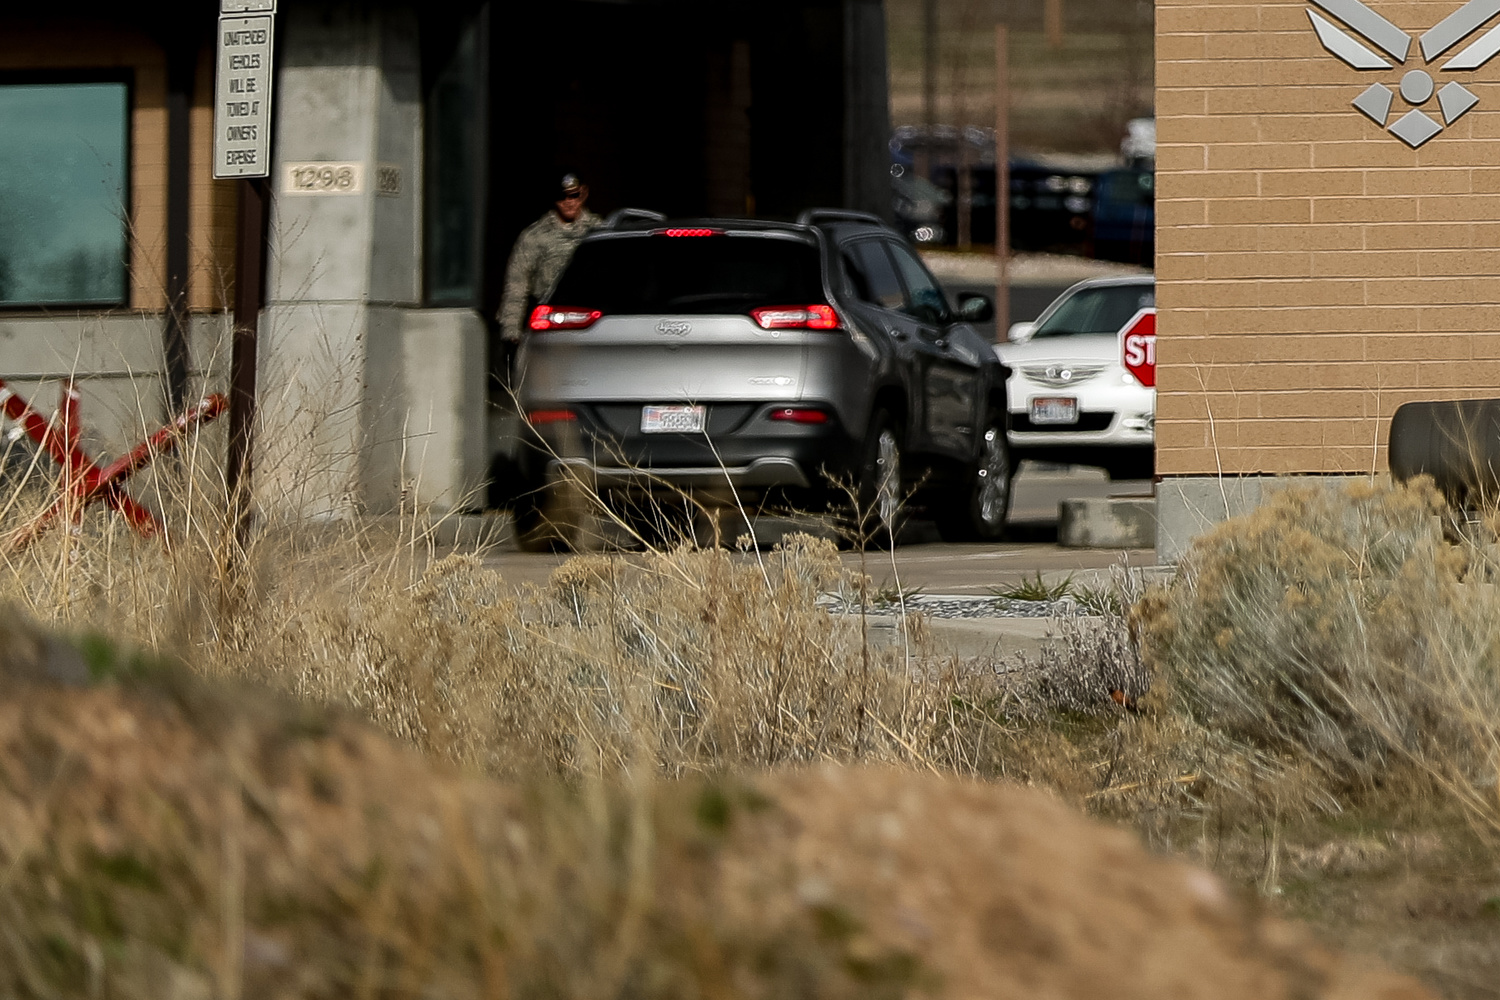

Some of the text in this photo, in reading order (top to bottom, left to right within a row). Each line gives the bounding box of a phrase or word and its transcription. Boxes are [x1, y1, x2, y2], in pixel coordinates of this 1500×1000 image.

[224, 30, 267, 46] UNATTENDED
[229, 53, 260, 69] VEHICLES
[229, 78, 256, 93] WILL BE
[226, 101, 260, 117] TOWED AT
[226, 149, 257, 165] EXPENSE
[1125, 334, 1156, 367] ST
